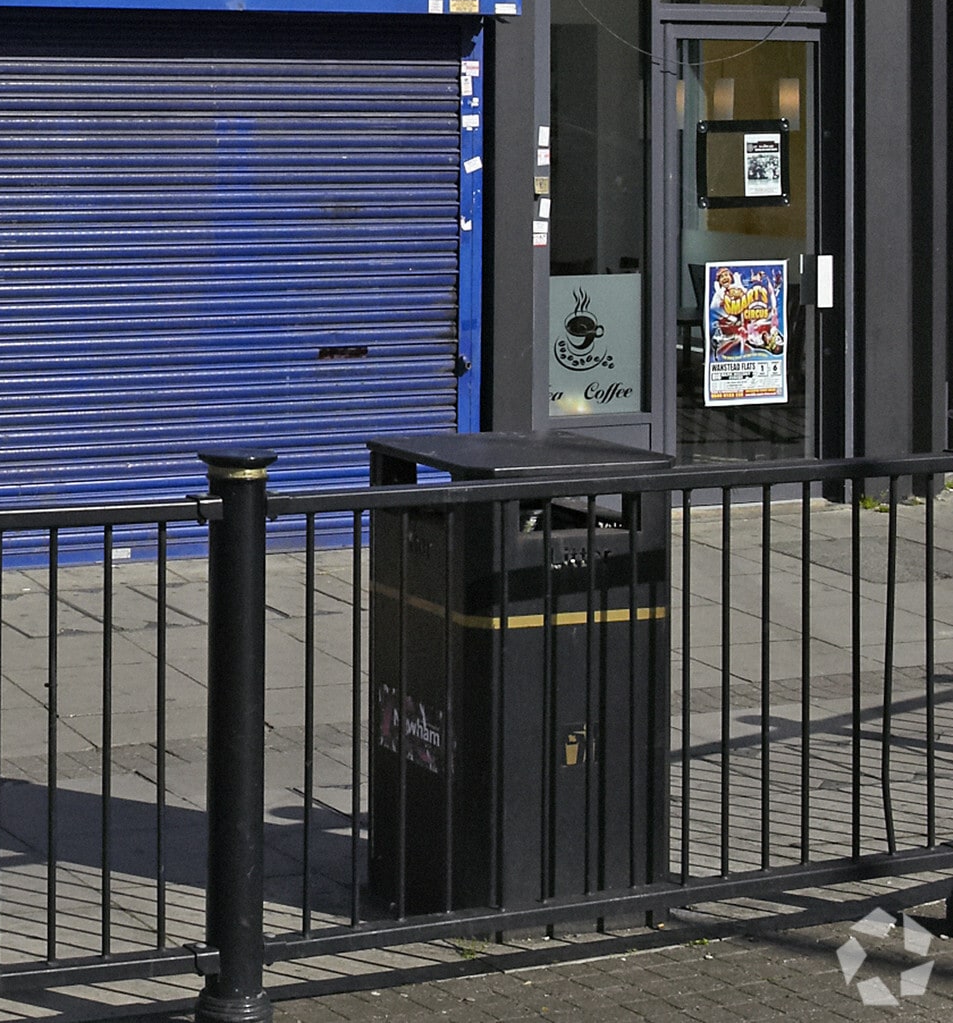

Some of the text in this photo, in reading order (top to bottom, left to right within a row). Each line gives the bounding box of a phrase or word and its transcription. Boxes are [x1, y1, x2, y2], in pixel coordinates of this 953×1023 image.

[743, 308, 769, 320] CIRCUS
[712, 363, 741, 372] WANSTEAD
[741, 362, 756, 371] FLATS
[583, 381, 633, 405] Coffee
